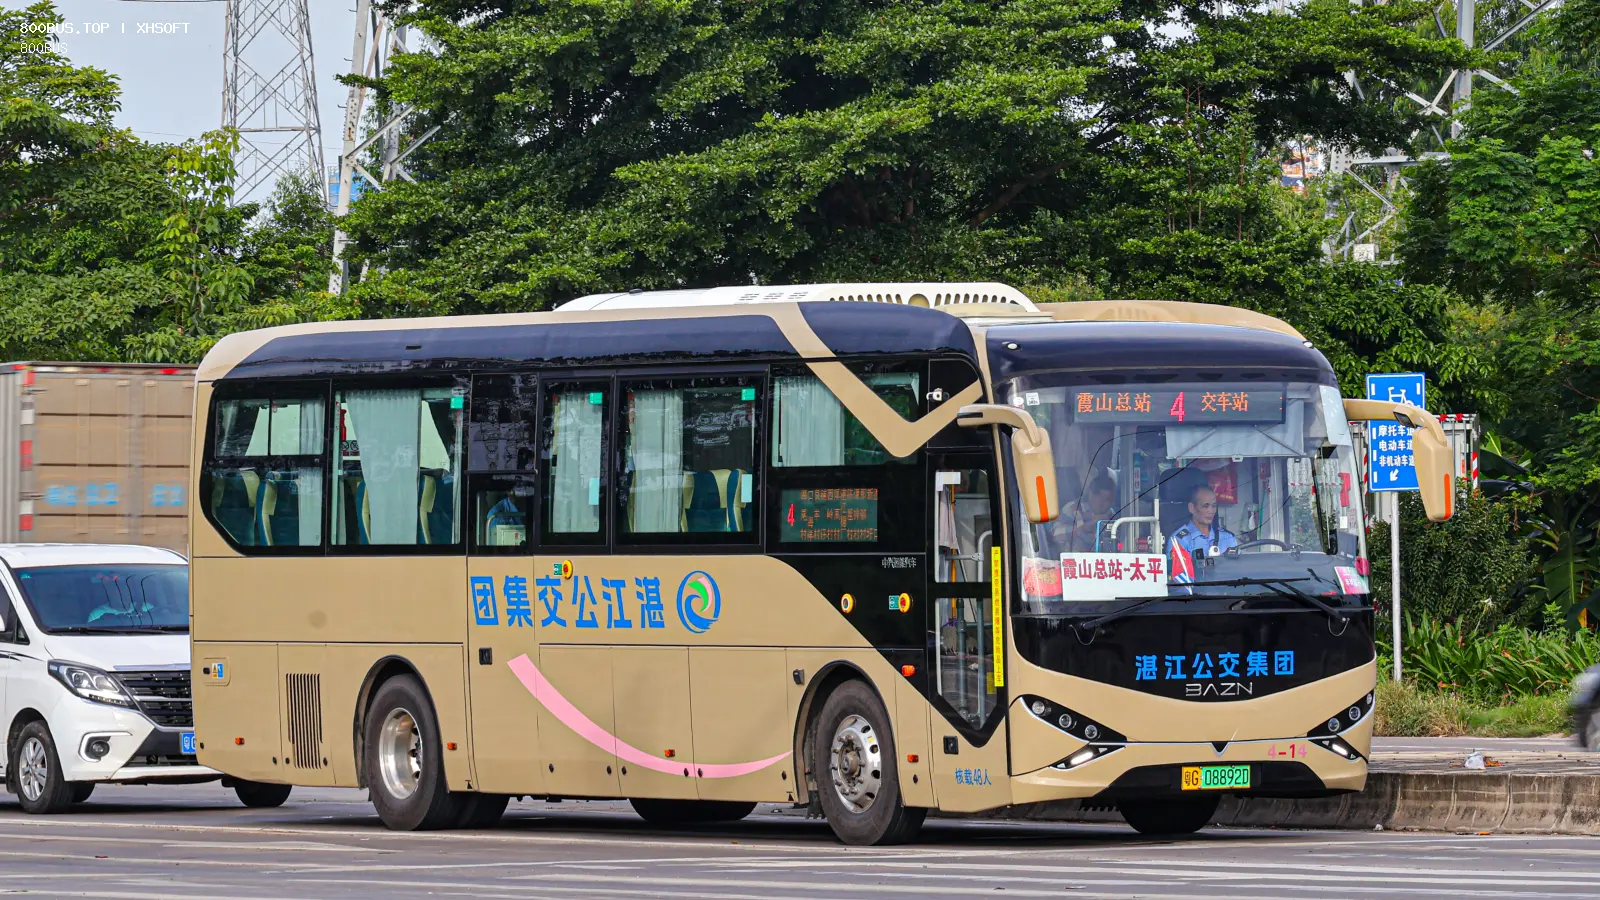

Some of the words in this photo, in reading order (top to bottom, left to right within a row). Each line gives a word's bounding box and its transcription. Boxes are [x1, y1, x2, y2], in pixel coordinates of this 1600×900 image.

[1077, 392, 1152, 413] 霞山总站
[1169, 391, 1186, 422] 4
[1201, 392, 1249, 412] 交车站
[787, 503, 796, 527] 4
[1135, 651, 1295, 681] 湛江公交集团
[1267, 743, 1307, 759] 4-14
[955, 767, 992, 785] 核载48人
